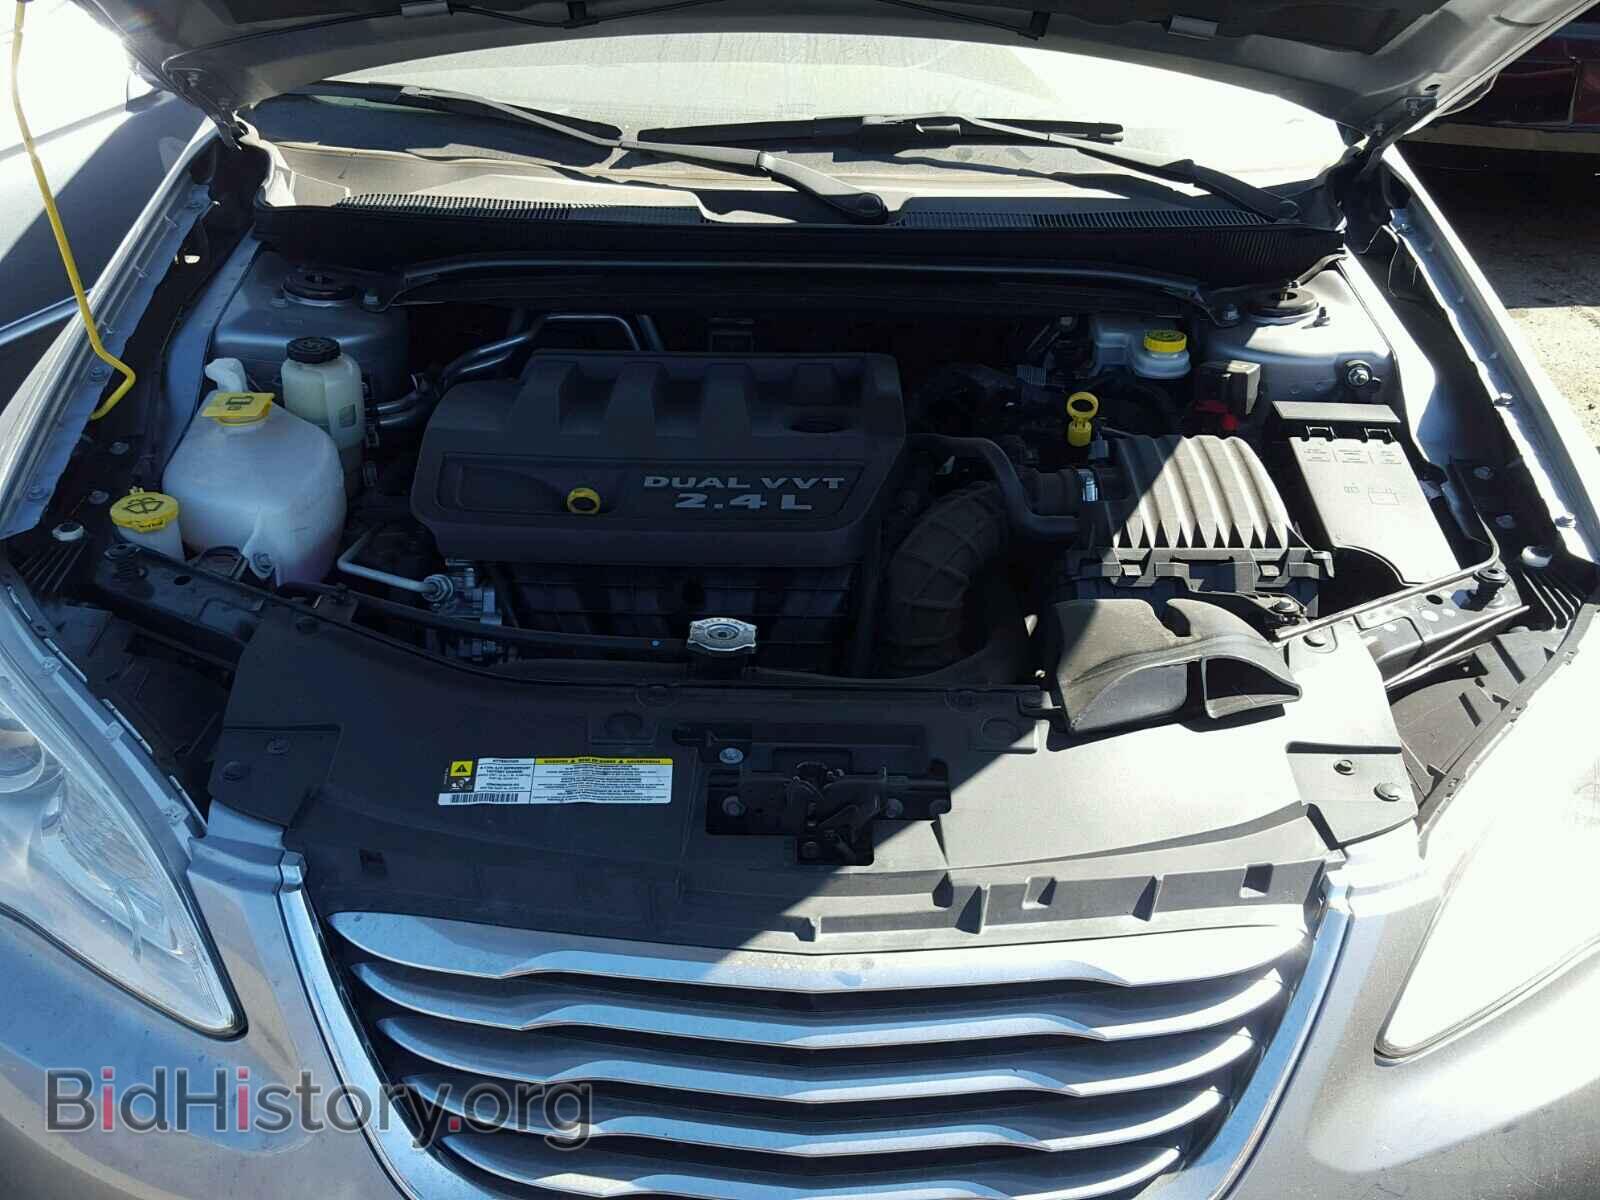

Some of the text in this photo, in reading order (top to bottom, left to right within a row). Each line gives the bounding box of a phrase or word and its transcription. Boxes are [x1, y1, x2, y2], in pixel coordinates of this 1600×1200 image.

[643, 476, 845, 489] DUAL VVT
[674, 493, 813, 510] 2.4 L
